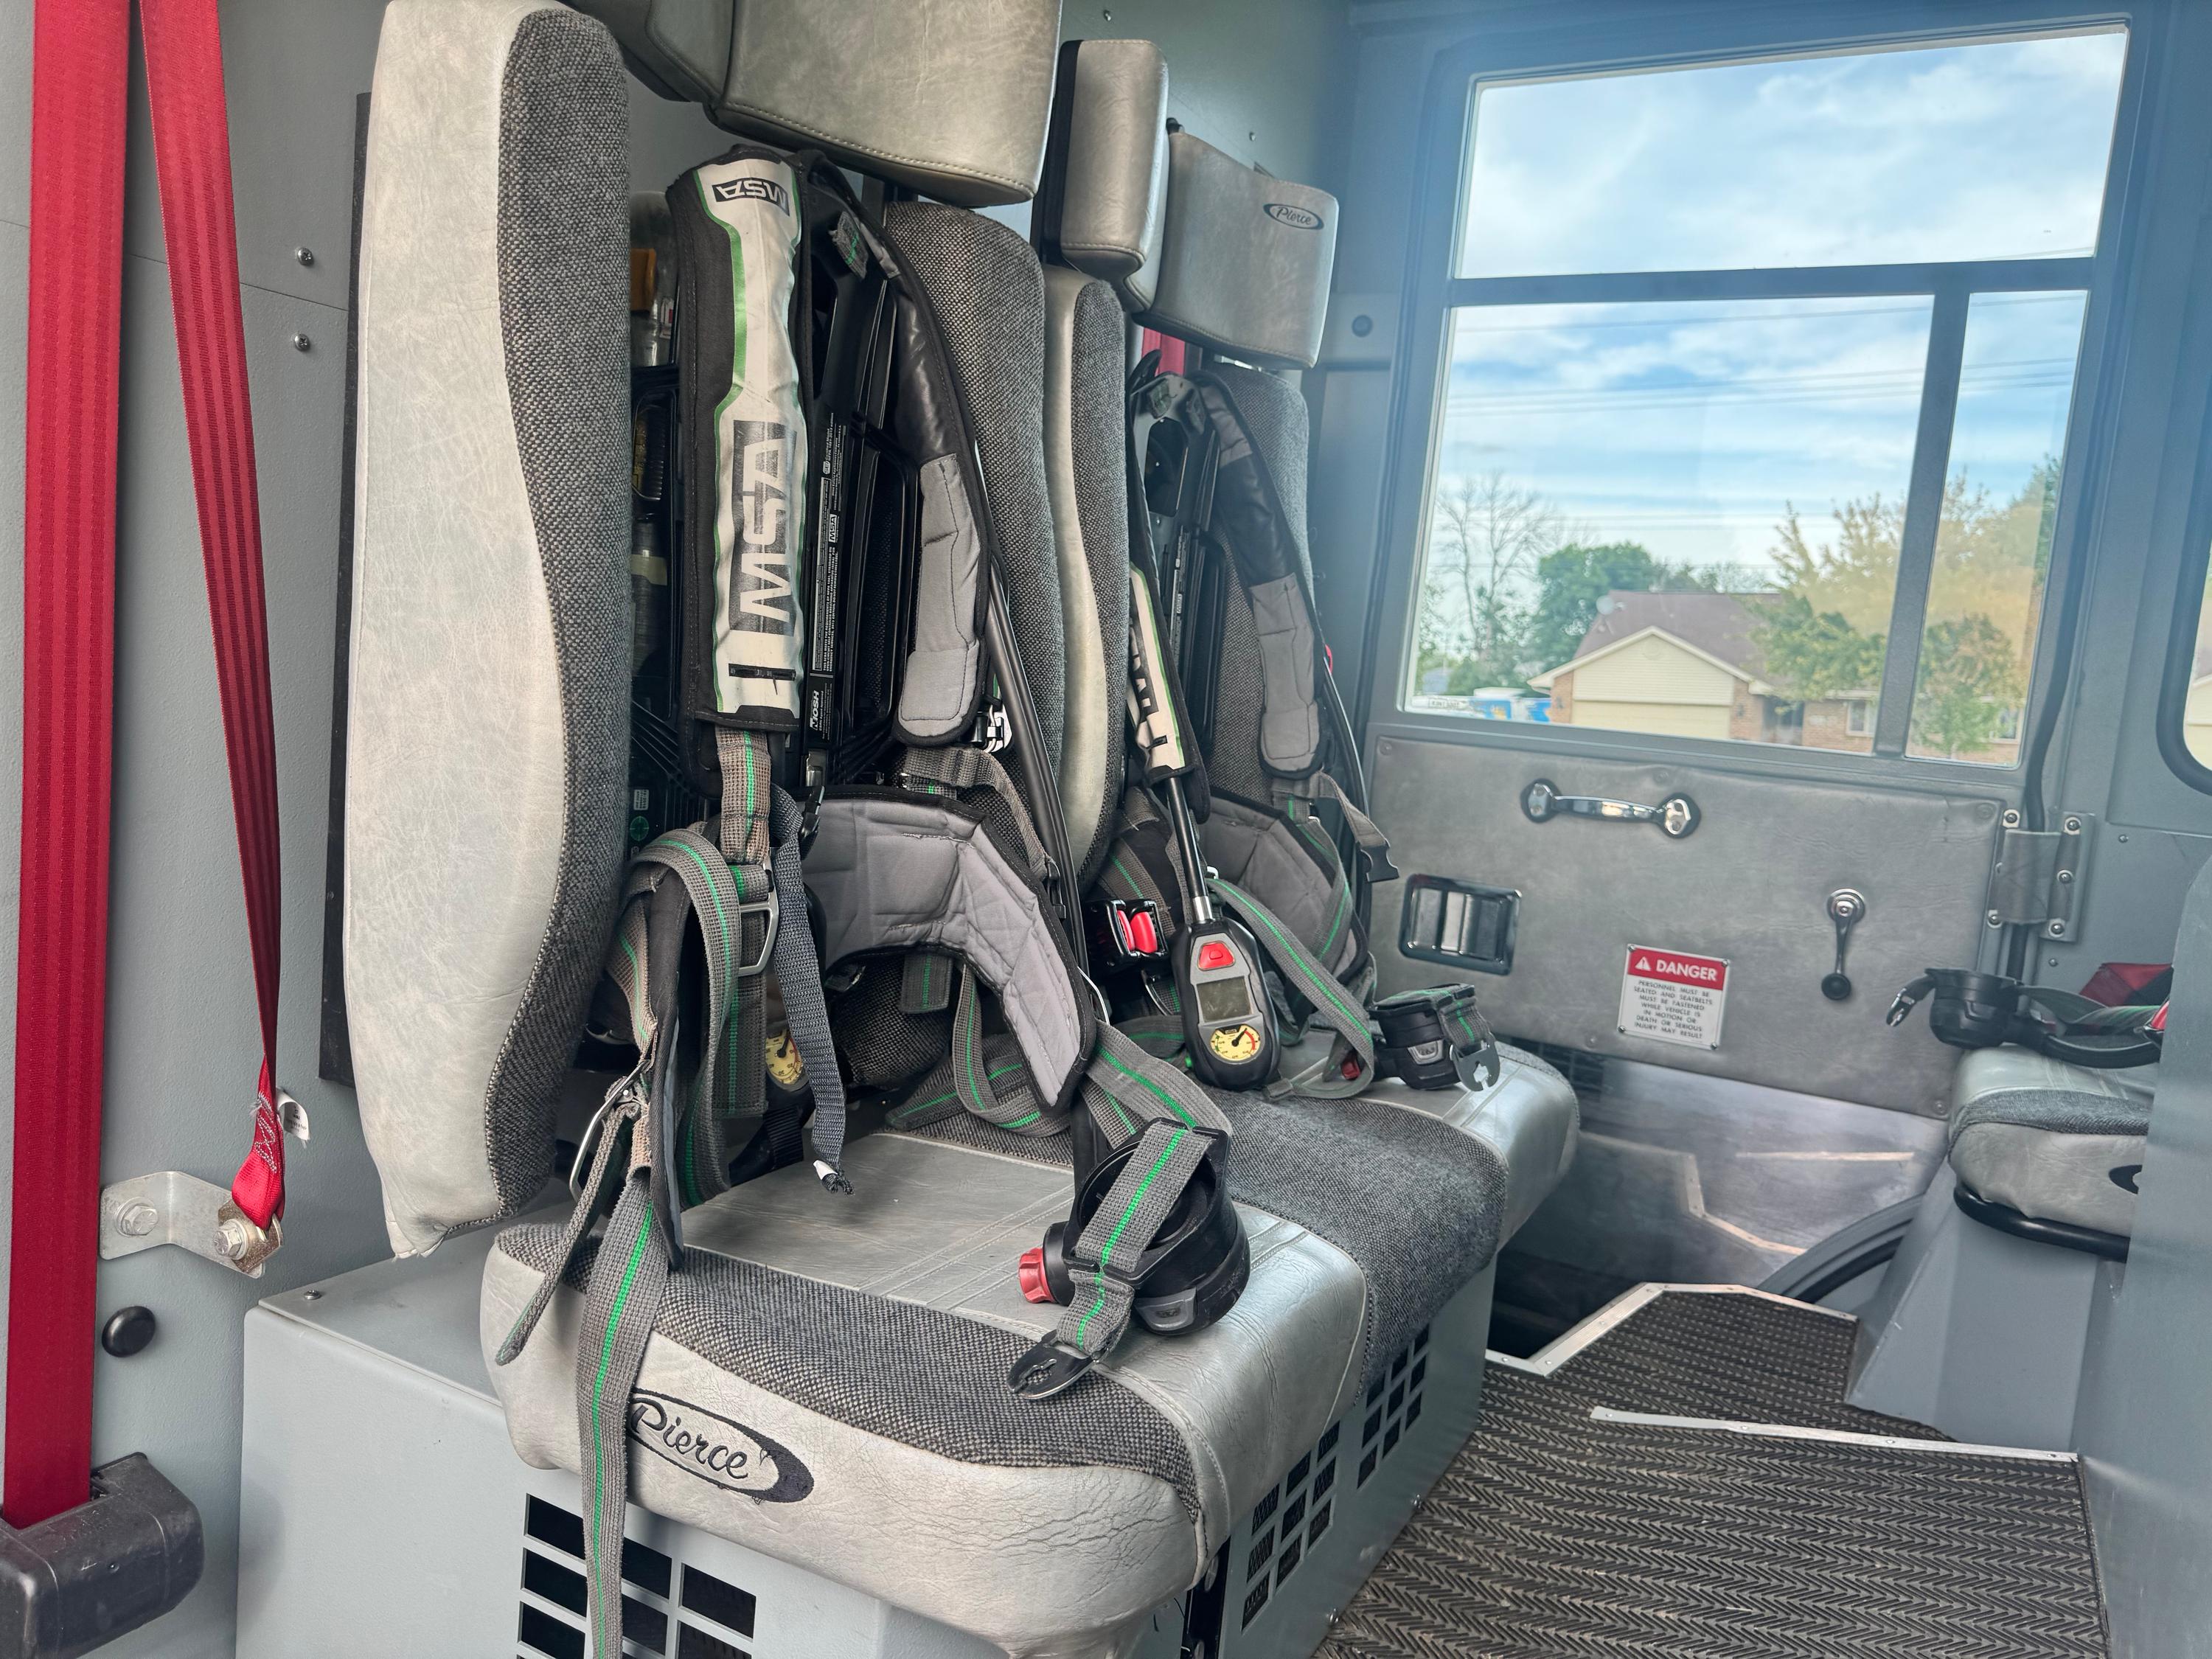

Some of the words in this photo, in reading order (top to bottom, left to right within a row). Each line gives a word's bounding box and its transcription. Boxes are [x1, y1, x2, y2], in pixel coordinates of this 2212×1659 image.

[715, 180, 787, 212] MSA
[1276, 206, 1312, 225] Pierce
[740, 437, 792, 623] MSA
[1656, 959, 1717, 981] DANGER
[1634, 985, 1656, 994] SEATED
[1680, 995, 1712, 1004] SEATBELTS
[1638, 980, 1675, 991] PERSONNEL
[1641, 1002, 1661, 1010] WHILE
[1666, 1007, 1691, 1015] VEHICLE
[1672, 1001, 1704, 1010] FASTENED
[1636, 1015, 1657, 1023] DEATH
[1675, 1022, 1702, 1032] SERIOUS
[1656, 1012, 1683, 1021] MOTION
[1634, 1022, 1657, 1031] INJURY
[1680, 1031, 1703, 1039] RESULT
[630, 1397, 748, 1479] Pierce
